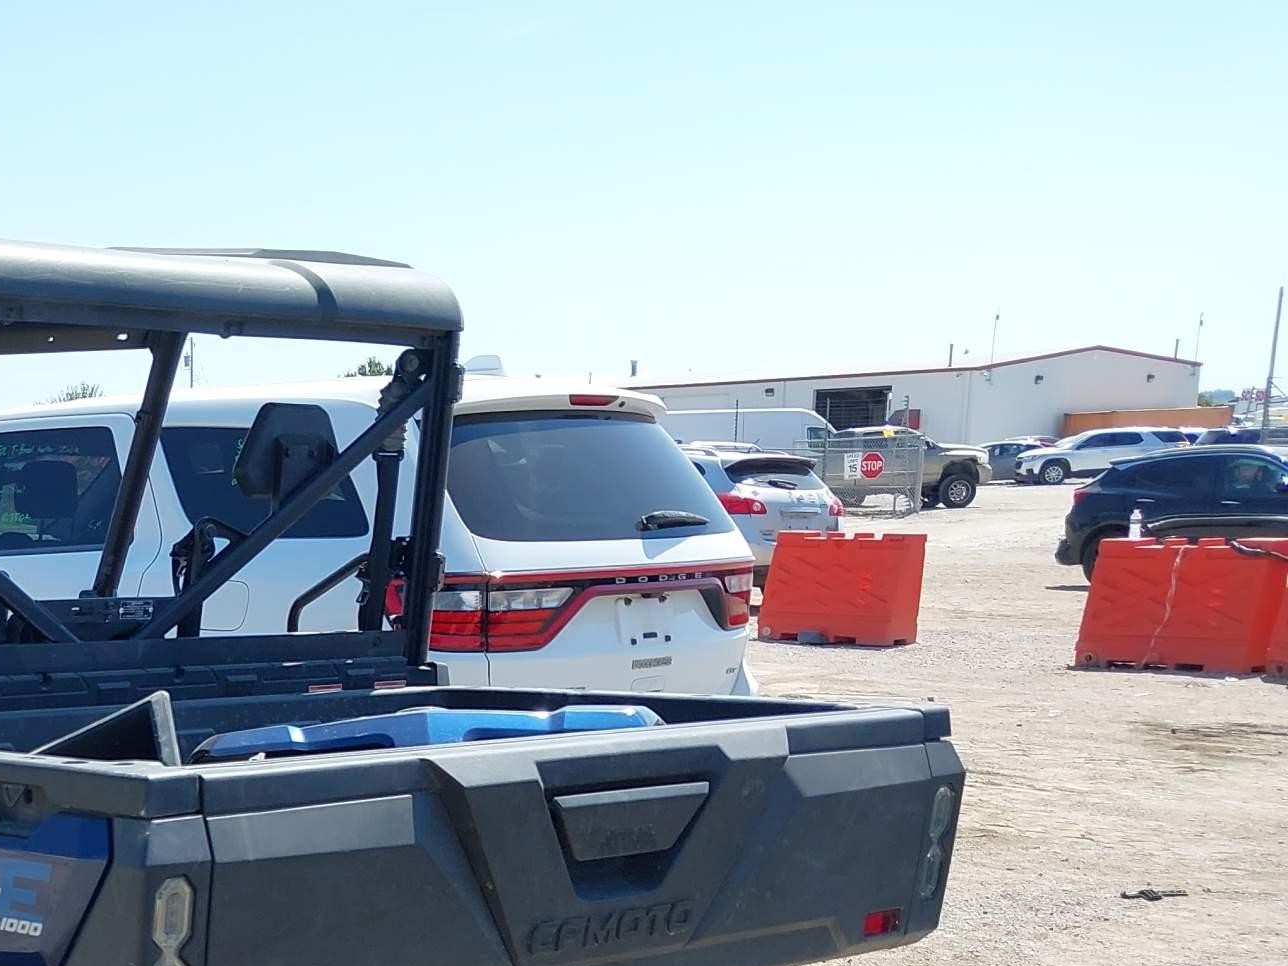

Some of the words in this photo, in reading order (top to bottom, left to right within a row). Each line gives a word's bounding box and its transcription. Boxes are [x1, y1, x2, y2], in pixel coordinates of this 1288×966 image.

[848, 463, 858, 473] 15
[861, 460, 883, 471] STOP
[615, 571, 704, 584] DODGE
[0, 917, 44, 937] 1000
[526, 898, 695, 955] CFMOTO
